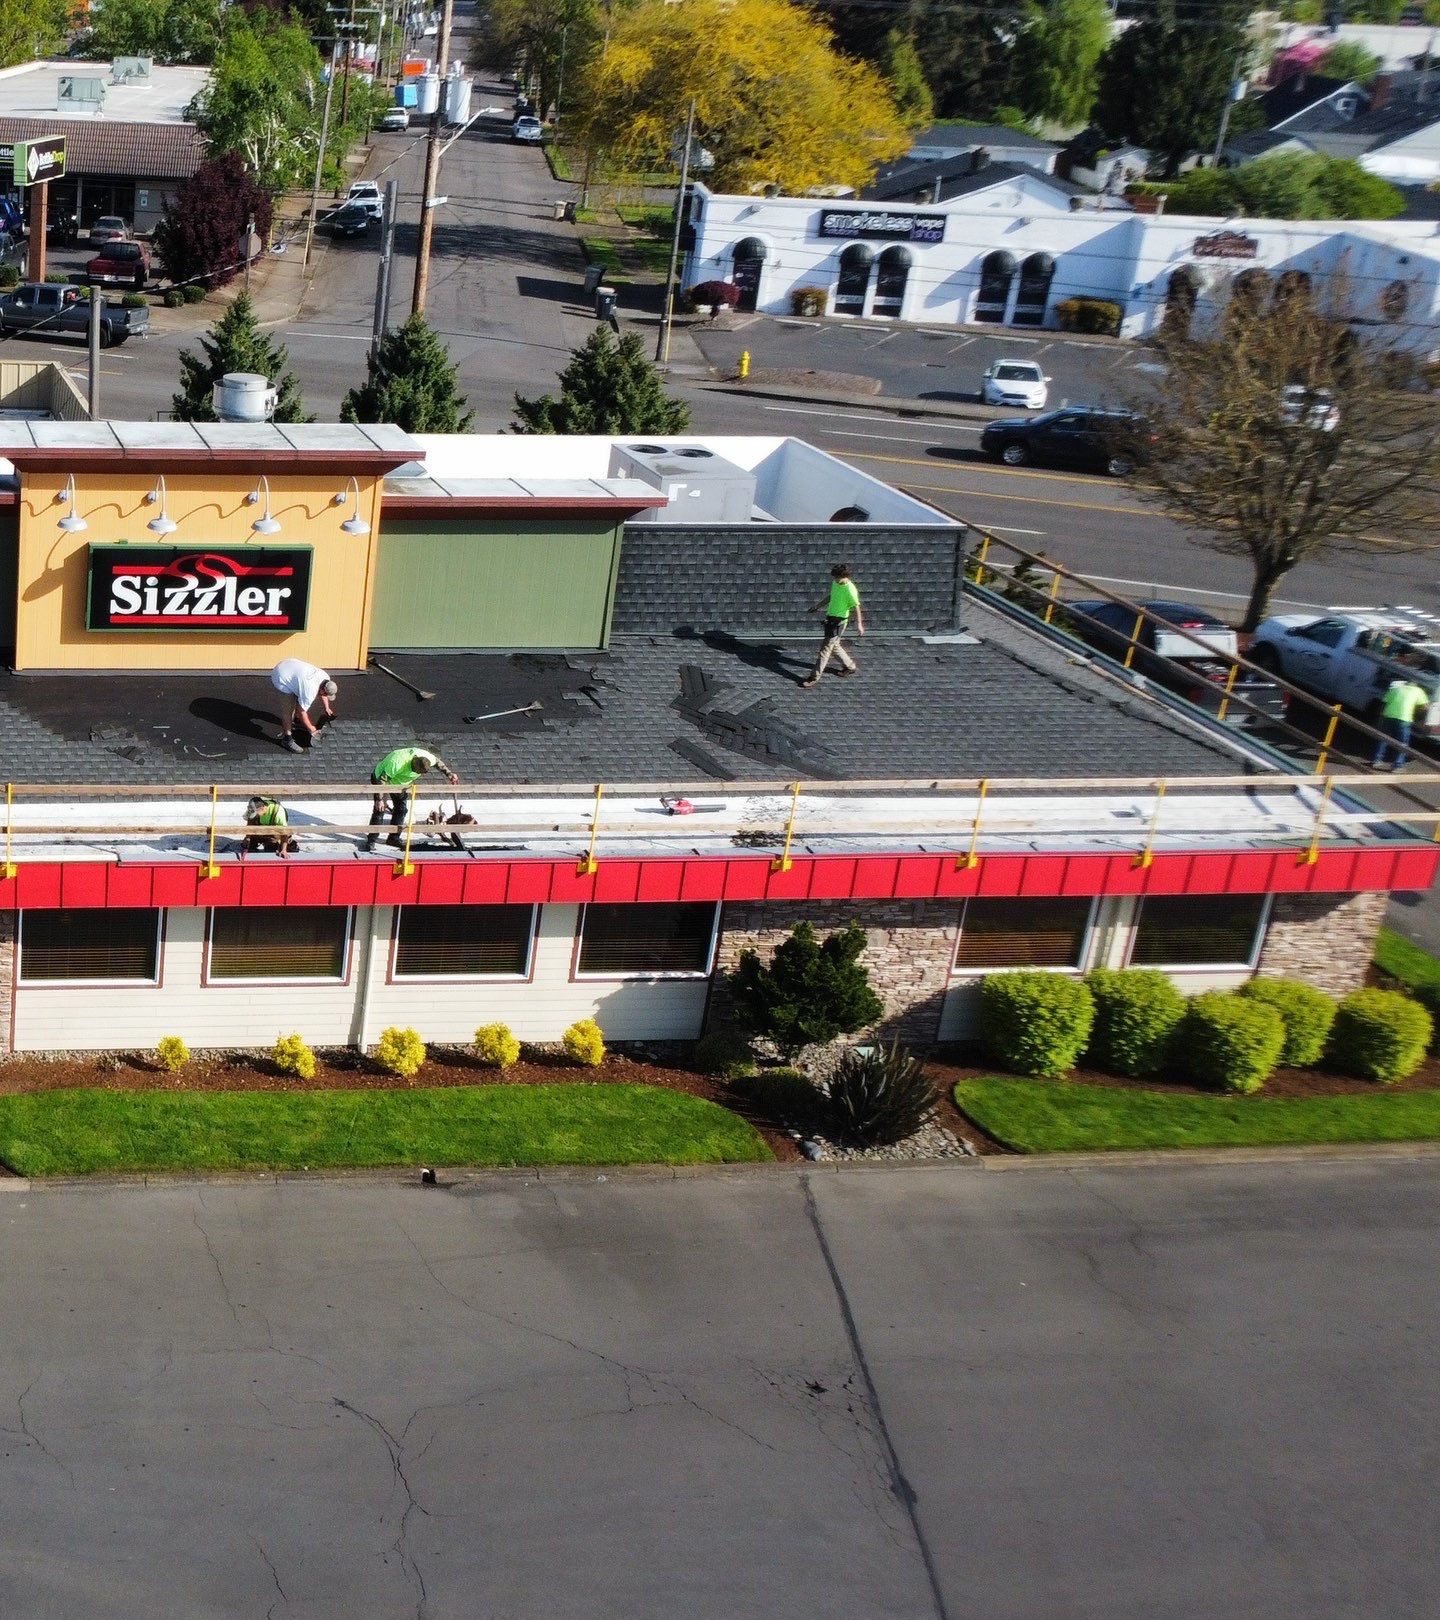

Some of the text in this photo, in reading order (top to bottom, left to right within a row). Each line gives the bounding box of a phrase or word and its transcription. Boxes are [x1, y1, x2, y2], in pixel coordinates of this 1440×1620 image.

[823, 212, 945, 232] smokeless vape
[110, 574, 292, 616] Sizzler
